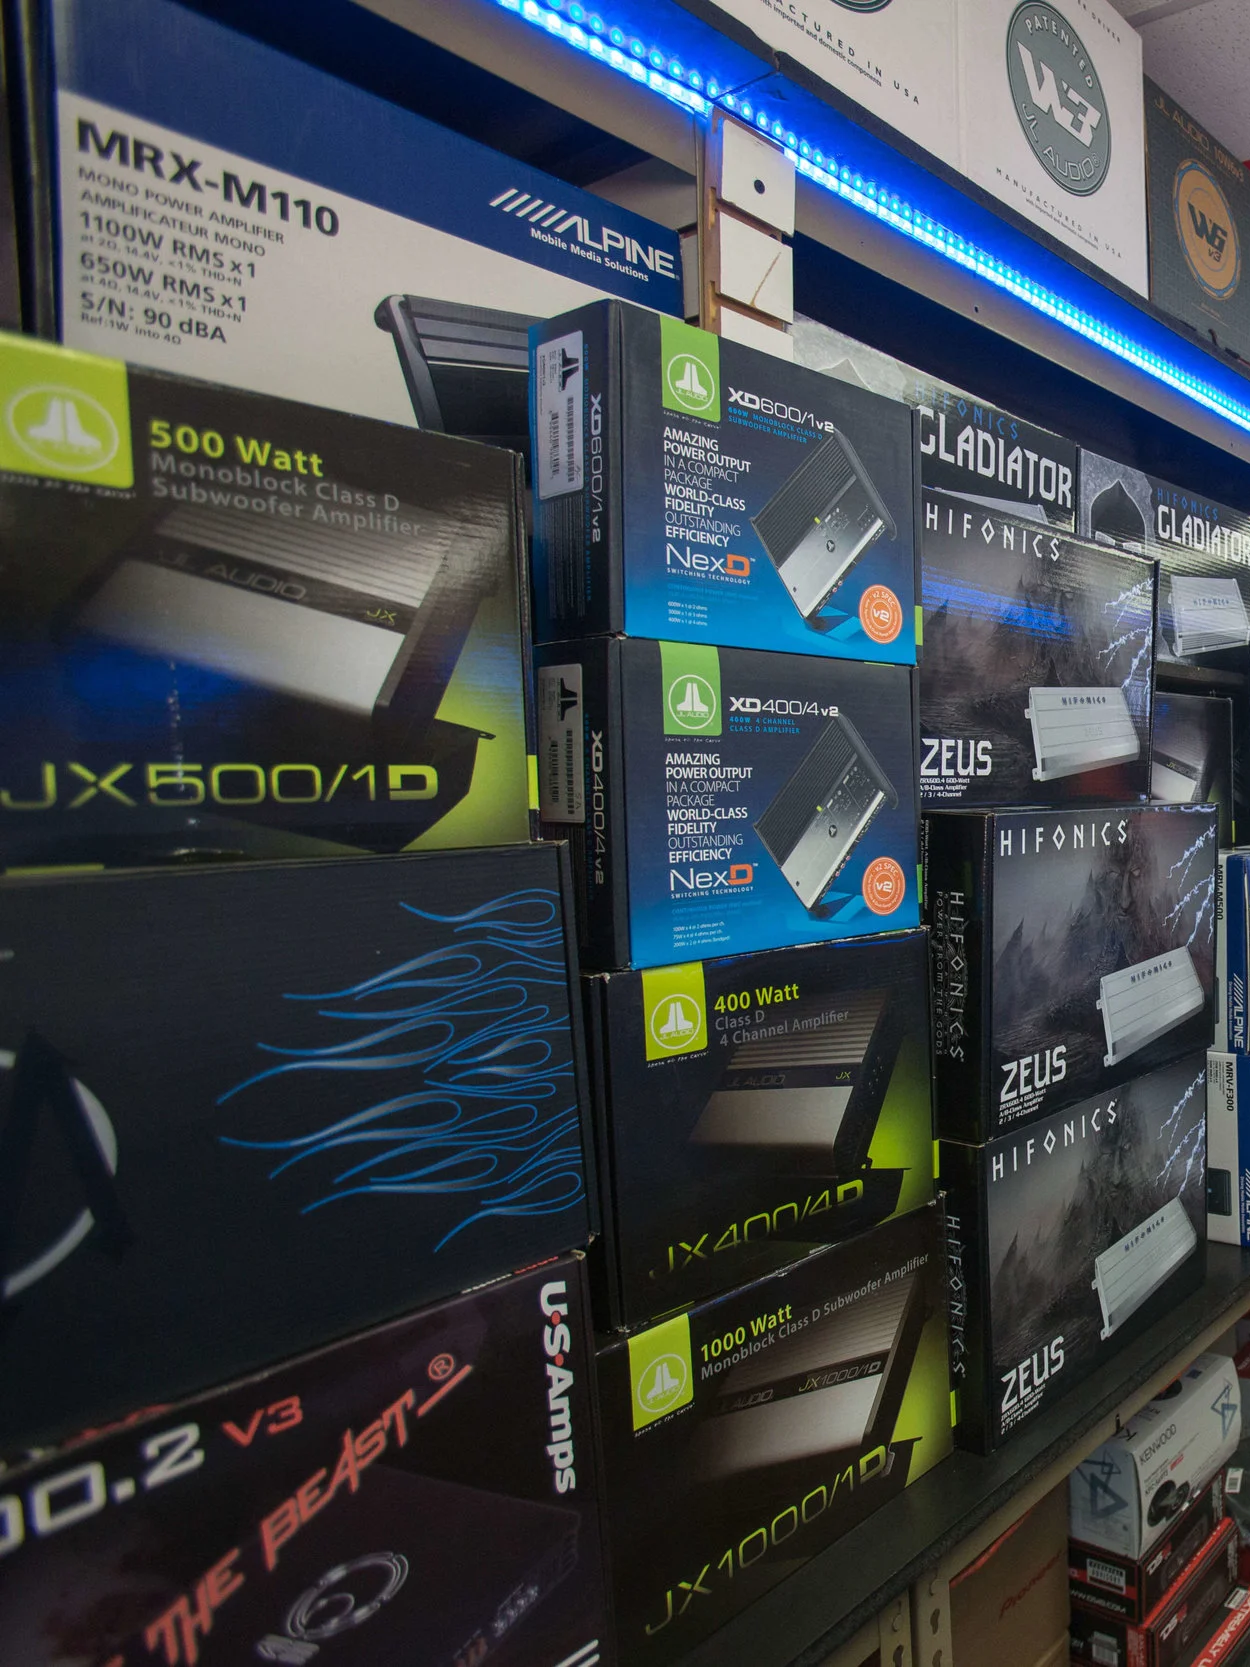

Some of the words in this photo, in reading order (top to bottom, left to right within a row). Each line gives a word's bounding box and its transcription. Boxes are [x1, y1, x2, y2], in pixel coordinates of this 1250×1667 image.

[805, 27, 818, 41] and
[846, 56, 882, 87] components
[1025, 15, 1094, 90] PATENTED
[867, 61, 882, 77] IN
[893, 80, 920, 105] USA
[77, 117, 340, 237] MRX-M110
[78, 166, 139, 197] MONO
[144, 186, 204, 218] POWER
[208, 209, 285, 245] AMPLIFIER
[996, 167, 1082, 232] MANUFACTURED
[80, 189, 210, 241] AMPLIFICATEUR
[214, 231, 266, 257] MONO
[80, 211, 164, 250] 1100W
[171, 237, 225, 270] RMS
[531, 227, 568, 251] Mobile
[570, 243, 602, 264] Media
[604, 256, 649, 283] Solutions
[80, 252, 154, 285] 650W
[162, 273, 216, 304] RMS
[80, 291, 134, 322] S/N:
[143, 307, 172, 330] 90
[179, 316, 227, 344] dBA
[663, 426, 719, 452] AMAZING
[727, 415, 771, 433] SUBWOOFER
[772, 428, 808, 444] AMPLIFIER
[752, 413, 795, 433] MONOBLOCK
[149, 419, 225, 459] 500
[236, 434, 324, 478] Watt
[663, 439, 706, 462] POWER
[706, 451, 751, 473] OUTPUT
[916, 403, 1073, 510] GLADIATOR
[150, 451, 308, 498] Monoblock
[315, 482, 377, 508] Class
[382, 492, 400, 513] D
[664, 468, 713, 491] PACKAGE
[677, 458, 686, 471] A
[687, 460, 739, 484] COMPACT
[152, 477, 304, 521] Subwoofer
[311, 503, 422, 538] Amplifier
[664, 482, 746, 512] WORLD-CLASS
[664, 496, 715, 518] FIDELITY
[1157, 487, 1220, 522] HIFONICS
[664, 510, 741, 537] OUTSTANDING
[665, 525, 730, 548] EFFICIENCY
[925, 502, 1061, 562] HIFONICS
[205, 562, 307, 601] AUDIO
[665, 542, 751, 577] NexD
[666, 567, 706, 579] SWITCHING
[708, 573, 751, 586] TECHNOLOGY
[665, 752, 721, 766] AMAZING
[665, 767, 708, 780] POWER
[708, 766, 753, 780] OUTPUT
[920, 738, 993, 777] ZEUS
[0, 761, 438, 811] JX500/1D
[666, 794, 716, 807] PACKAGE
[679, 780, 688, 794] A
[689, 780, 741, 794] COMPACT
[666, 806, 748, 821] WORLD-CLASS
[667, 821, 717, 836] FIDELITY
[667, 833, 744, 850] OUTSTANDING
[668, 847, 733, 864] EFFICIENCY
[999, 819, 1128, 857] HIFONICS
[669, 863, 754, 891] NexD
[711, 885, 754, 895] TECHNOLOGY
[1214, 864, 1224, 921] MRV-M500
[949, 890, 965, 1062] HIFONICS
[713, 991, 751, 1015] 400
[755, 982, 800, 1009] Watt
[714, 1011, 752, 1032] Class
[718, 1033, 729, 1047] 4
[731, 1020, 789, 1046] Channel
[791, 1009, 850, 1038] Amplifier
[1000, 1044, 1067, 1103] ZEUS
[1225, 1060, 1235, 1112] MRV-F300
[992, 1098, 1118, 1182] HIFONICS
[649, 1178, 864, 1280] JX400/4D
[700, 1332, 776, 1381] Monoblock
[778, 1316, 810, 1343] Class
[811, 1309, 822, 1322] D
[823, 1276, 882, 1316] Subwoofer
[883, 1251, 930, 1288] Amplifier
[946, 1215, 965, 1378] HIFONICS
[700, 1326, 747, 1364] 1000
[749, 1303, 793, 1338] Watt
[1000, 1335, 1065, 1415] ZEUS
[221, 1395, 304, 1448] V3
[144, 1547, 245, 1667] THE
[258, 1387, 418, 1572] BEAST
[645, 1444, 888, 1637] JX1000/1D
